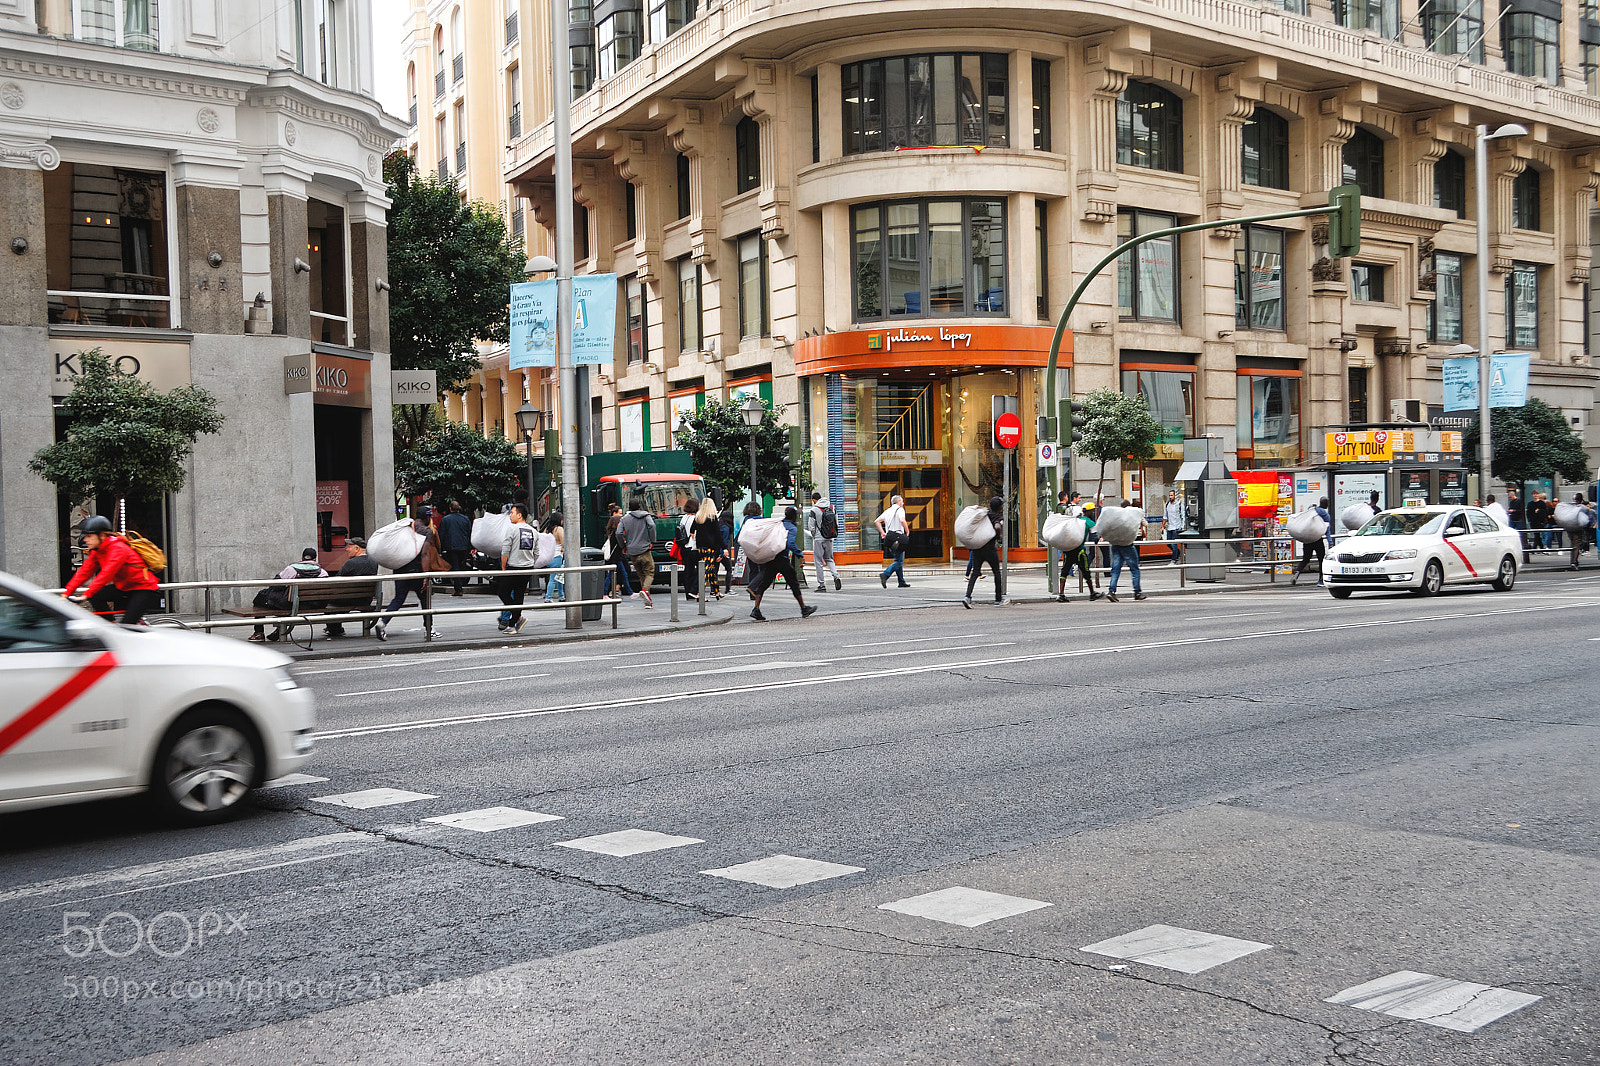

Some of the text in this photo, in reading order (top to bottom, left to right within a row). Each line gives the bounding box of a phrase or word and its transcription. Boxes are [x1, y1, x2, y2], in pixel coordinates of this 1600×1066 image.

[574, 288, 592, 297] Plan
[519, 308, 543, 318] respirar
[574, 299, 588, 330] A
[886, 327, 972, 351] julián lópez
[55, 353, 141, 376] KO
[286, 366, 308, 378] KIKO
[1491, 367, 1506, 387] A
[398, 382, 431, 391] KIKO
[1336, 442, 1385, 456] CITY TOUR
